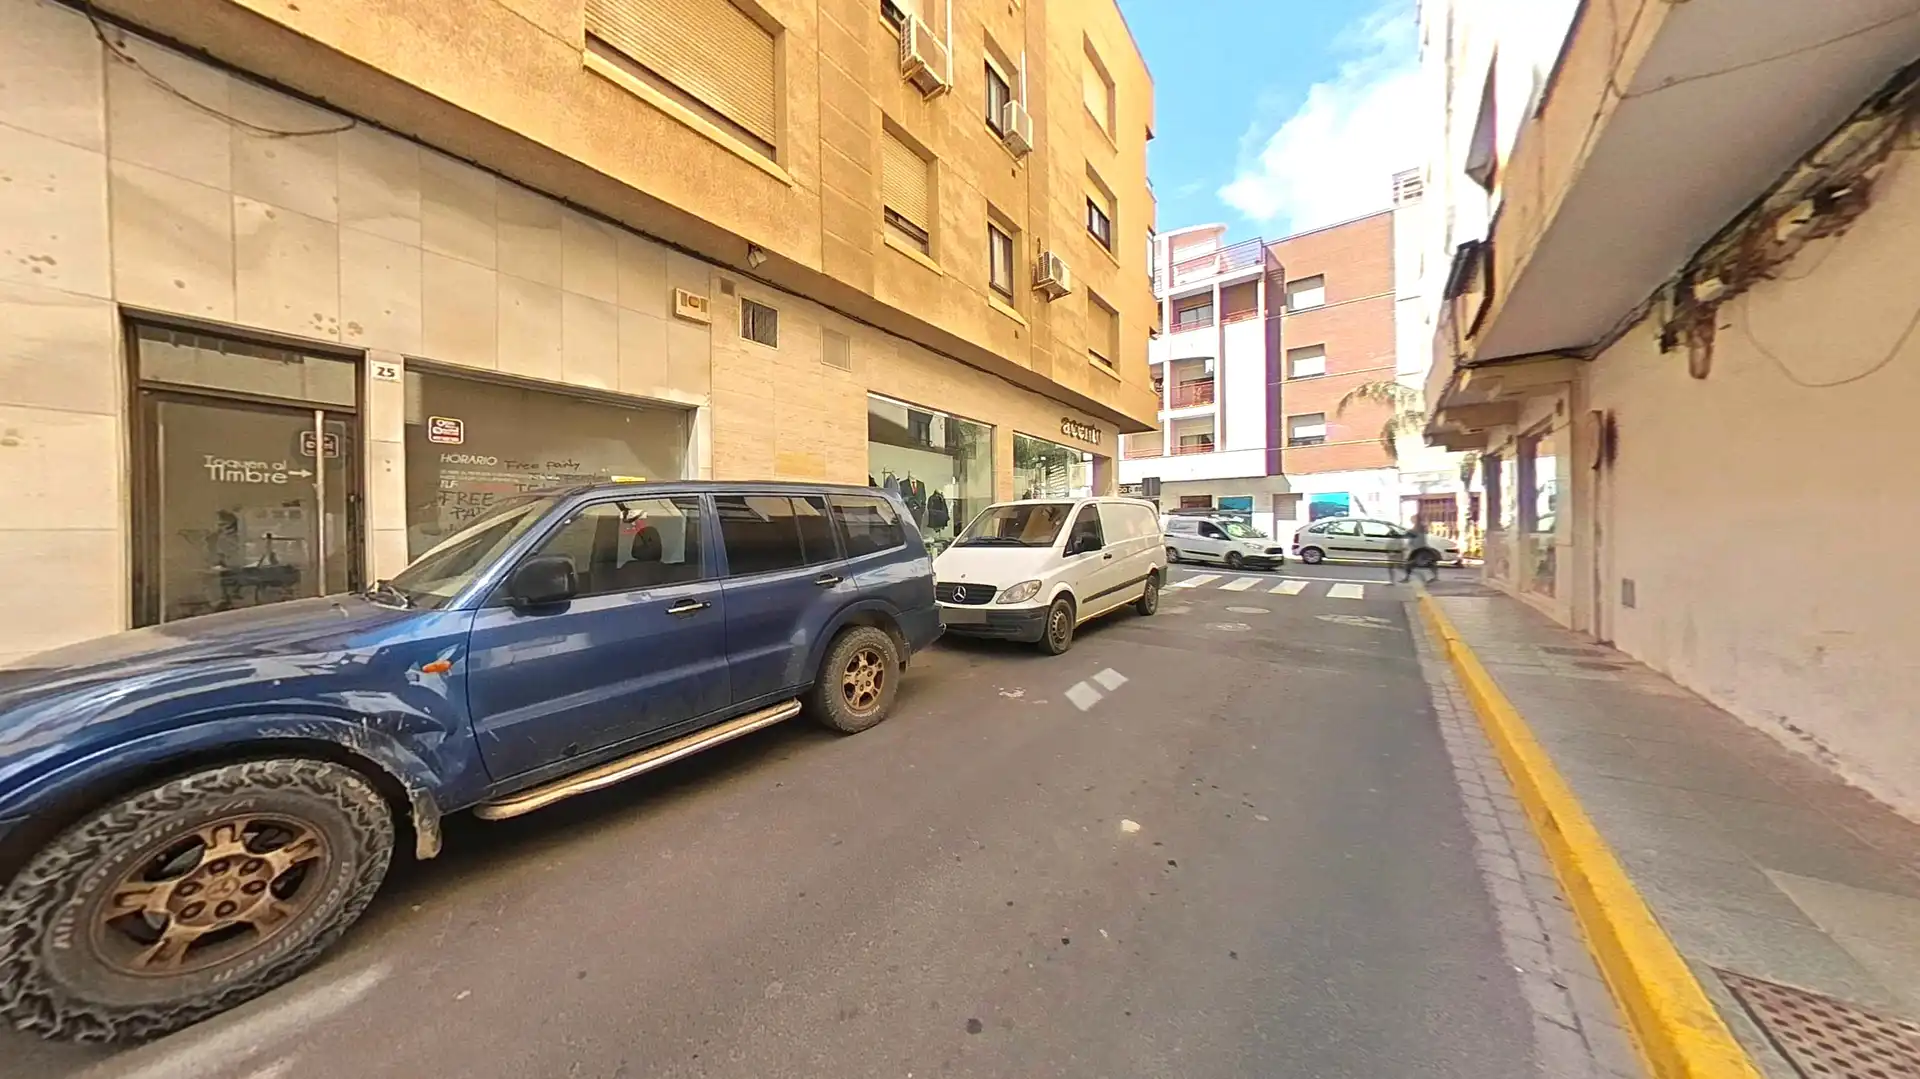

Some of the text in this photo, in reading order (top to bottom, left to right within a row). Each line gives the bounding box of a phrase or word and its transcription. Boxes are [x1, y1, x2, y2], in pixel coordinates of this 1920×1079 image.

[376, 366, 395, 378] 25
[440, 453, 498, 466] HORARIO
[438, 490, 495, 507] FREE
